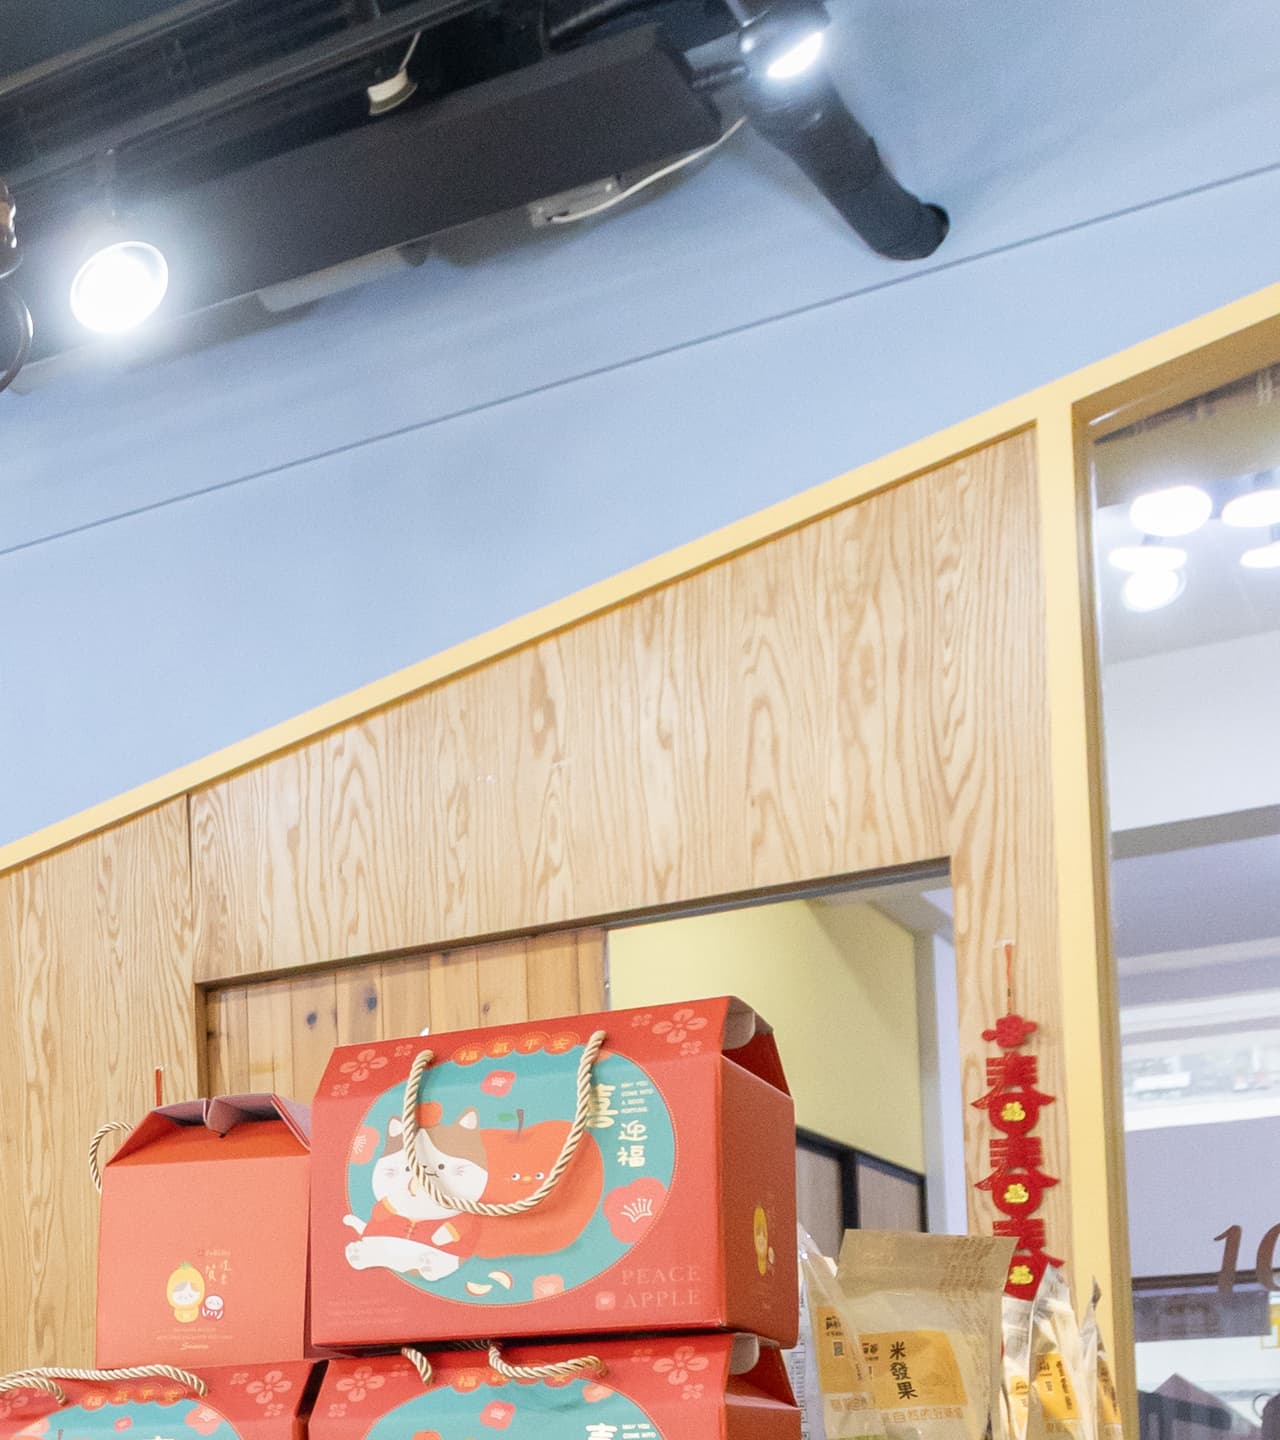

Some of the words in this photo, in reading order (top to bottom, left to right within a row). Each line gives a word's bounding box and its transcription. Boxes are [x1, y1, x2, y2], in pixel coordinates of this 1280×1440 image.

[617, 1119, 649, 1168] 迎福
[621, 1265, 701, 1286] PEACE
[623, 1288, 702, 1309] APPLE
[889, 1341, 919, 1401] 米發果
